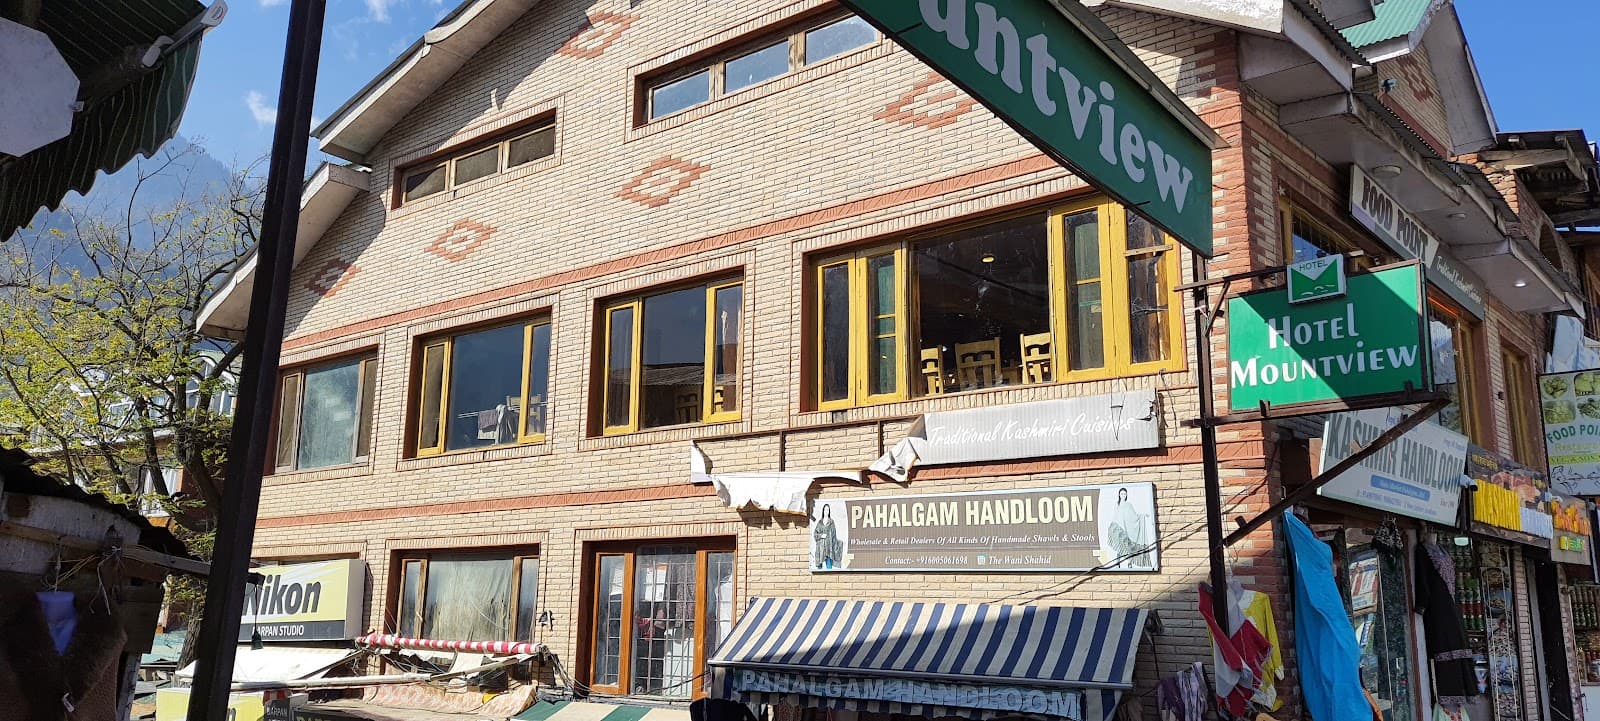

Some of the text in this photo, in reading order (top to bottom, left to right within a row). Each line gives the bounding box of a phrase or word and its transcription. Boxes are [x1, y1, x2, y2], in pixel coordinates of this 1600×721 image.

[1361, 175, 1429, 263] FOOD POINT
[1299, 259, 1329, 272] HOTEL
[929, 421, 1001, 448] Traditional
[1001, 417, 1066, 441] Kashmiri
[1547, 424, 1600, 444] FOOD POI
[1401, 437, 1463, 495] HANDLOOM
[851, 495, 1093, 529] PAHALGAM HANDLOOM
[850, 533, 1095, 546] Wholesale & Retail Dealers Of All Kinds Of Handmade Shawls & Stools
[989, 555, 1002, 565] The
[1003, 555, 1022, 565] Wani
[1024, 555, 1051, 565] Shahid
[242, 574, 322, 616] Nikon
[279, 624, 305, 636] STUDIO
[742, 670, 1082, 721] PAHALGAM HANDLOOM
